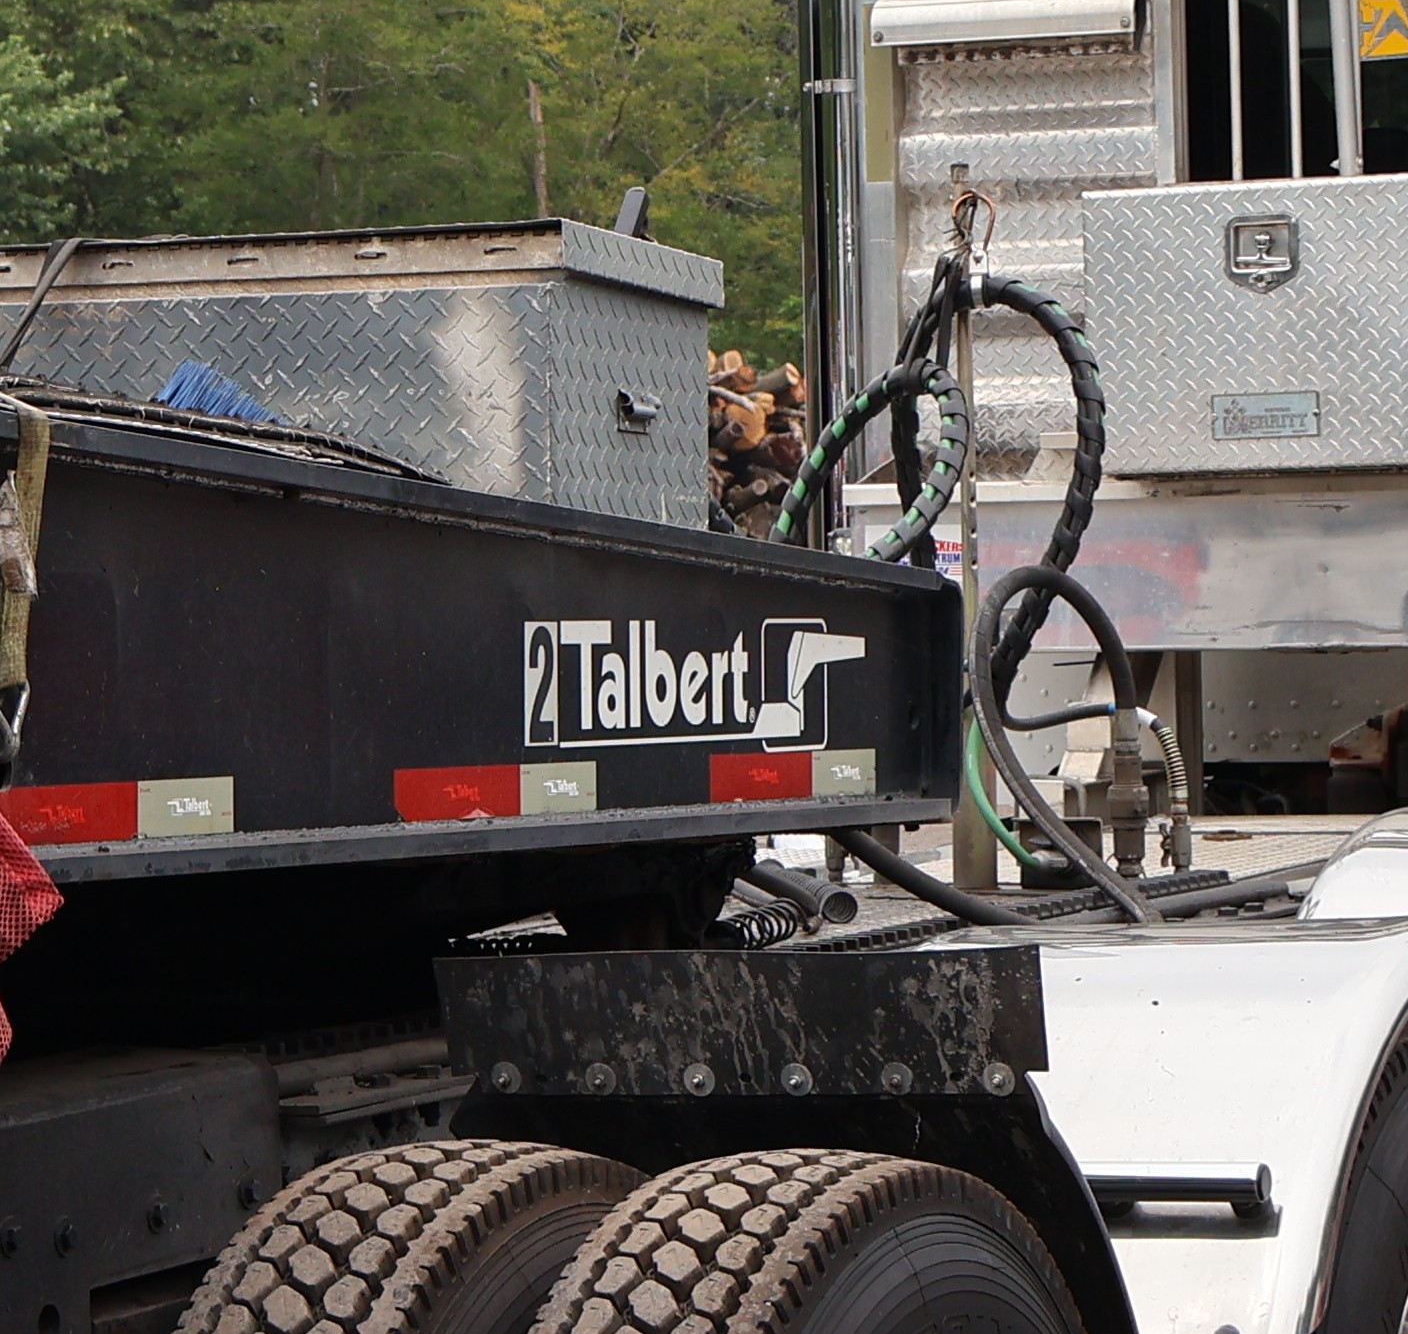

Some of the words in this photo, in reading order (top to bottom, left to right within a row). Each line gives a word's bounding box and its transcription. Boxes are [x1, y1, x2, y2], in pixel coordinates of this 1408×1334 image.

[936, 552, 961, 563] TRUM
[527, 623, 556, 745] 2
[560, 619, 749, 731] Talbert
